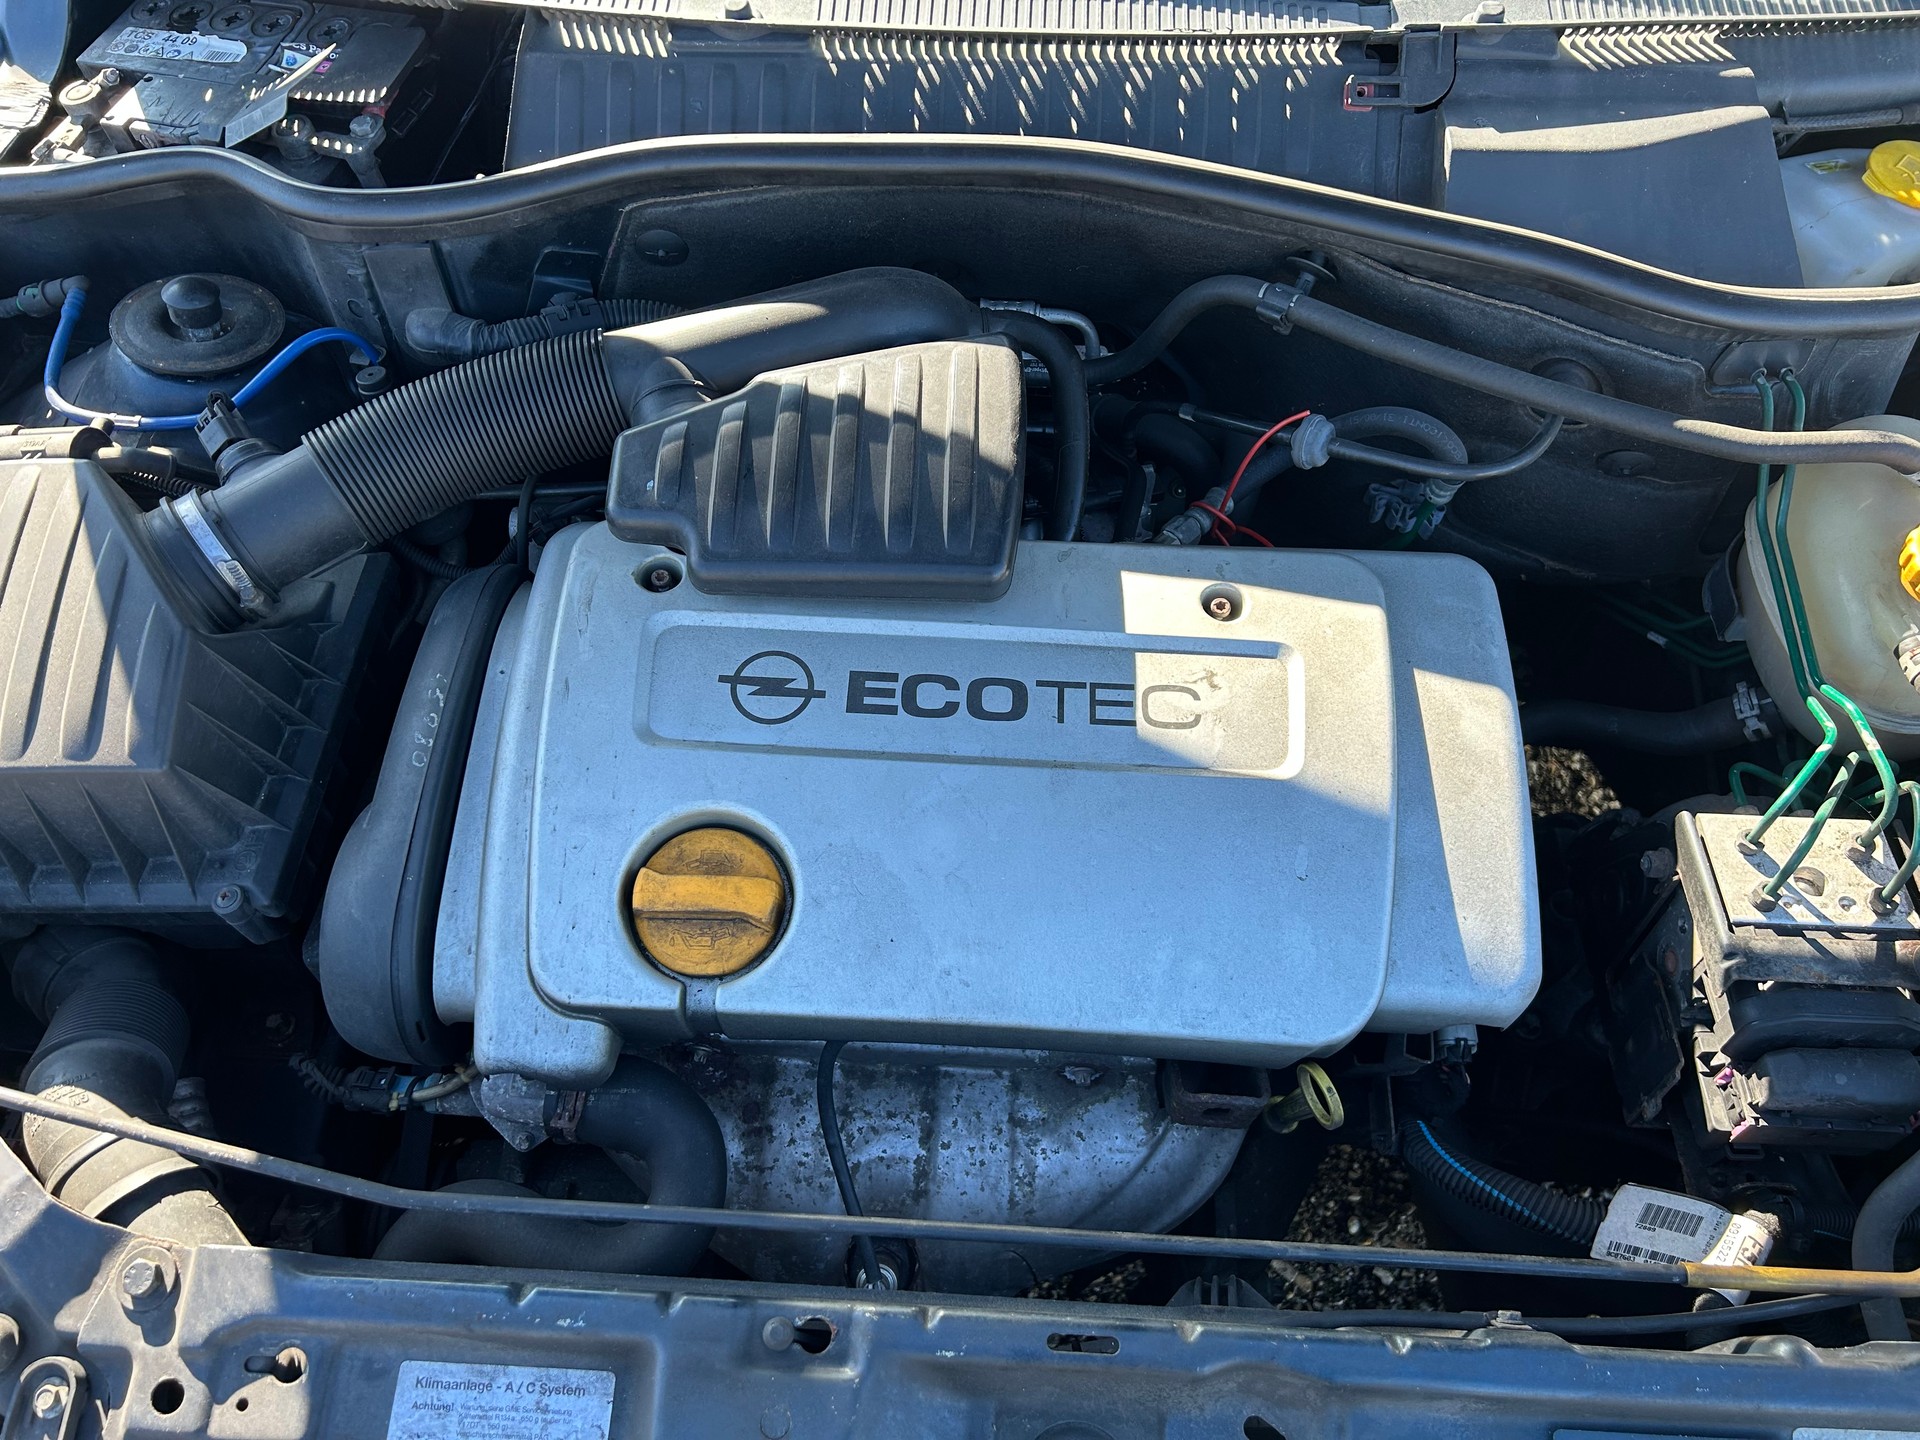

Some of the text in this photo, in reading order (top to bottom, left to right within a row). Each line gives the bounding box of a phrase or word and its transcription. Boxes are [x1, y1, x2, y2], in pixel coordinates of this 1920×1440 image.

[845, 670, 1202, 730] ECOTEC
[415, 1376, 493, 1394] Klimaanlage
[539, 1382, 586, 1397] System
[411, 1400, 455, 1413] Achtung!
